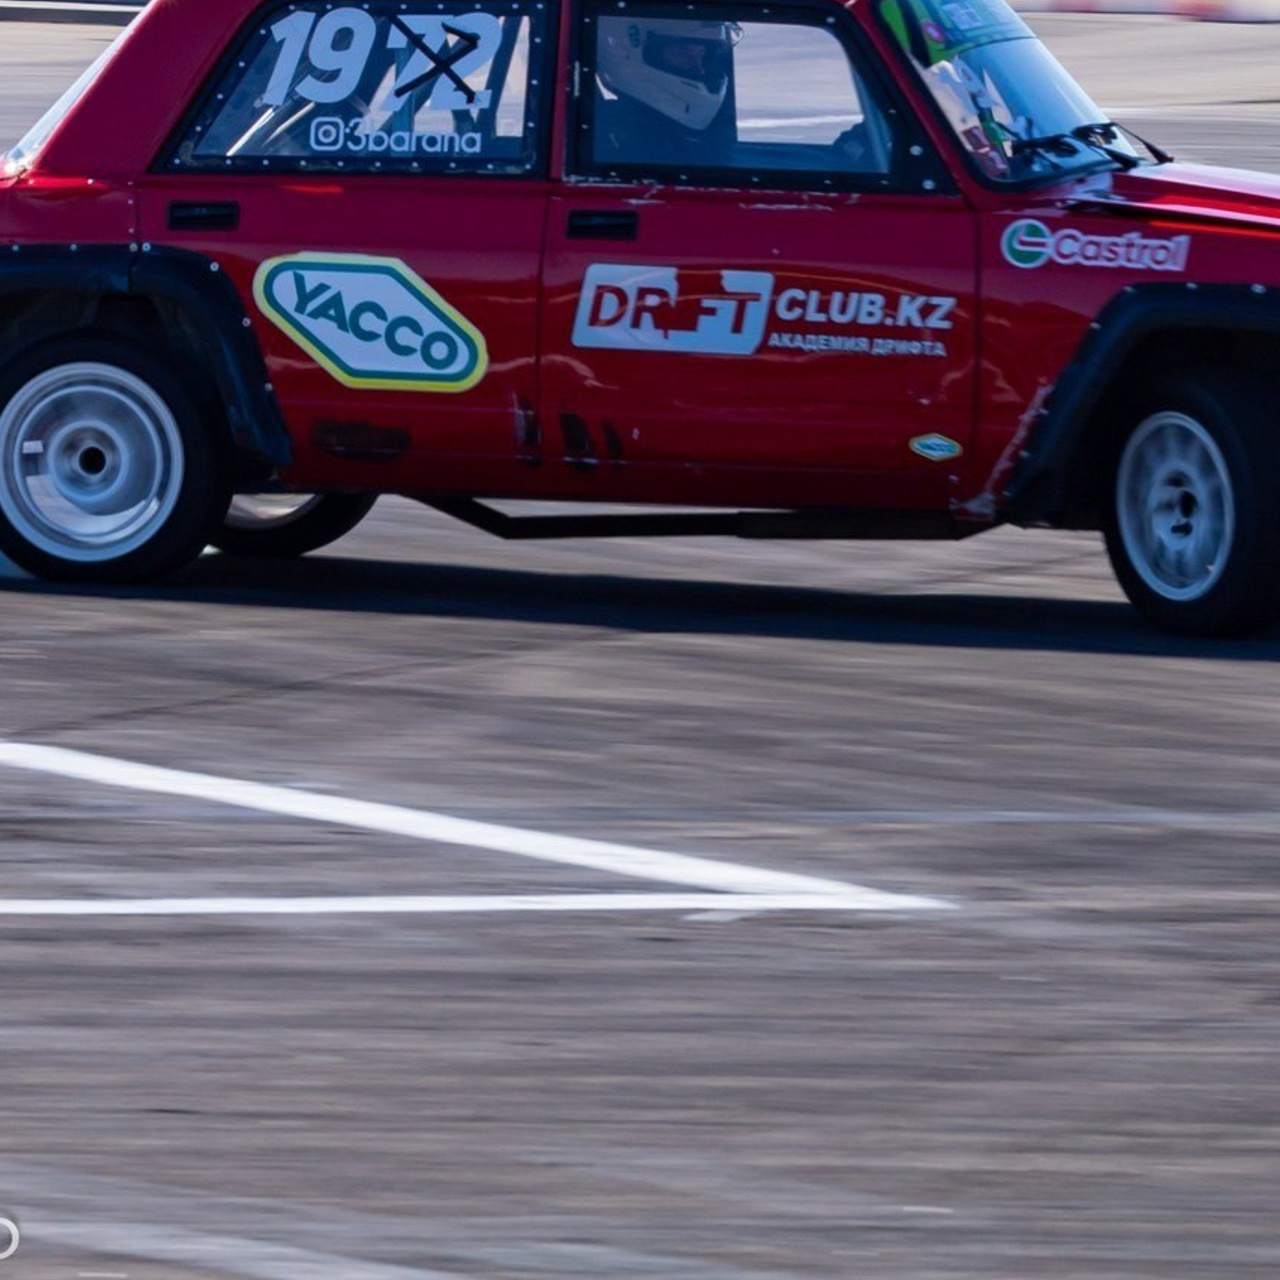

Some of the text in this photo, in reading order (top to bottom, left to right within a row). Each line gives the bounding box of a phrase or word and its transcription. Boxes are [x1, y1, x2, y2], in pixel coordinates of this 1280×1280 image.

[1051, 228, 1191, 271] Castrol
[292, 270, 459, 370] YACCO
[775, 288, 957, 329] CLUB.KZ
[768, 332, 870, 353] АКАДЕМИЯ
